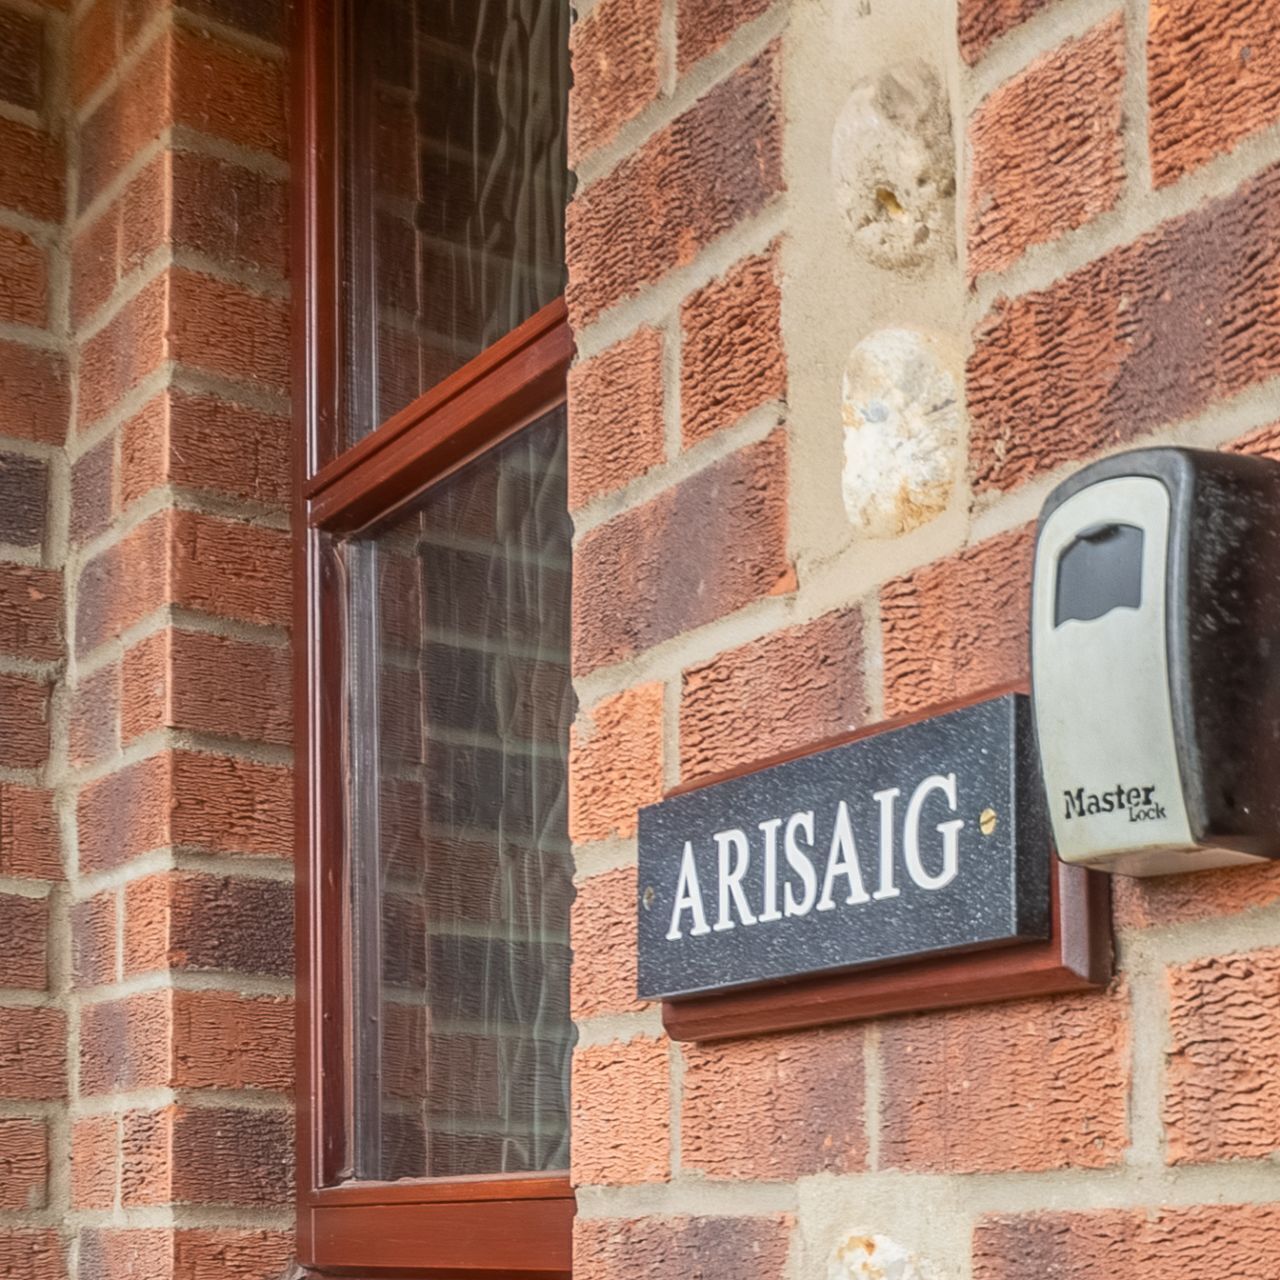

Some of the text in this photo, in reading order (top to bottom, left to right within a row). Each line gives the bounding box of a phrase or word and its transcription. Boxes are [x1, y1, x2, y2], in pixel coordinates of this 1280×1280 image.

[1064, 784, 1156, 819] Master
[1128, 802, 1167, 822] Lock
[665, 772, 964, 940] ARISAIG
